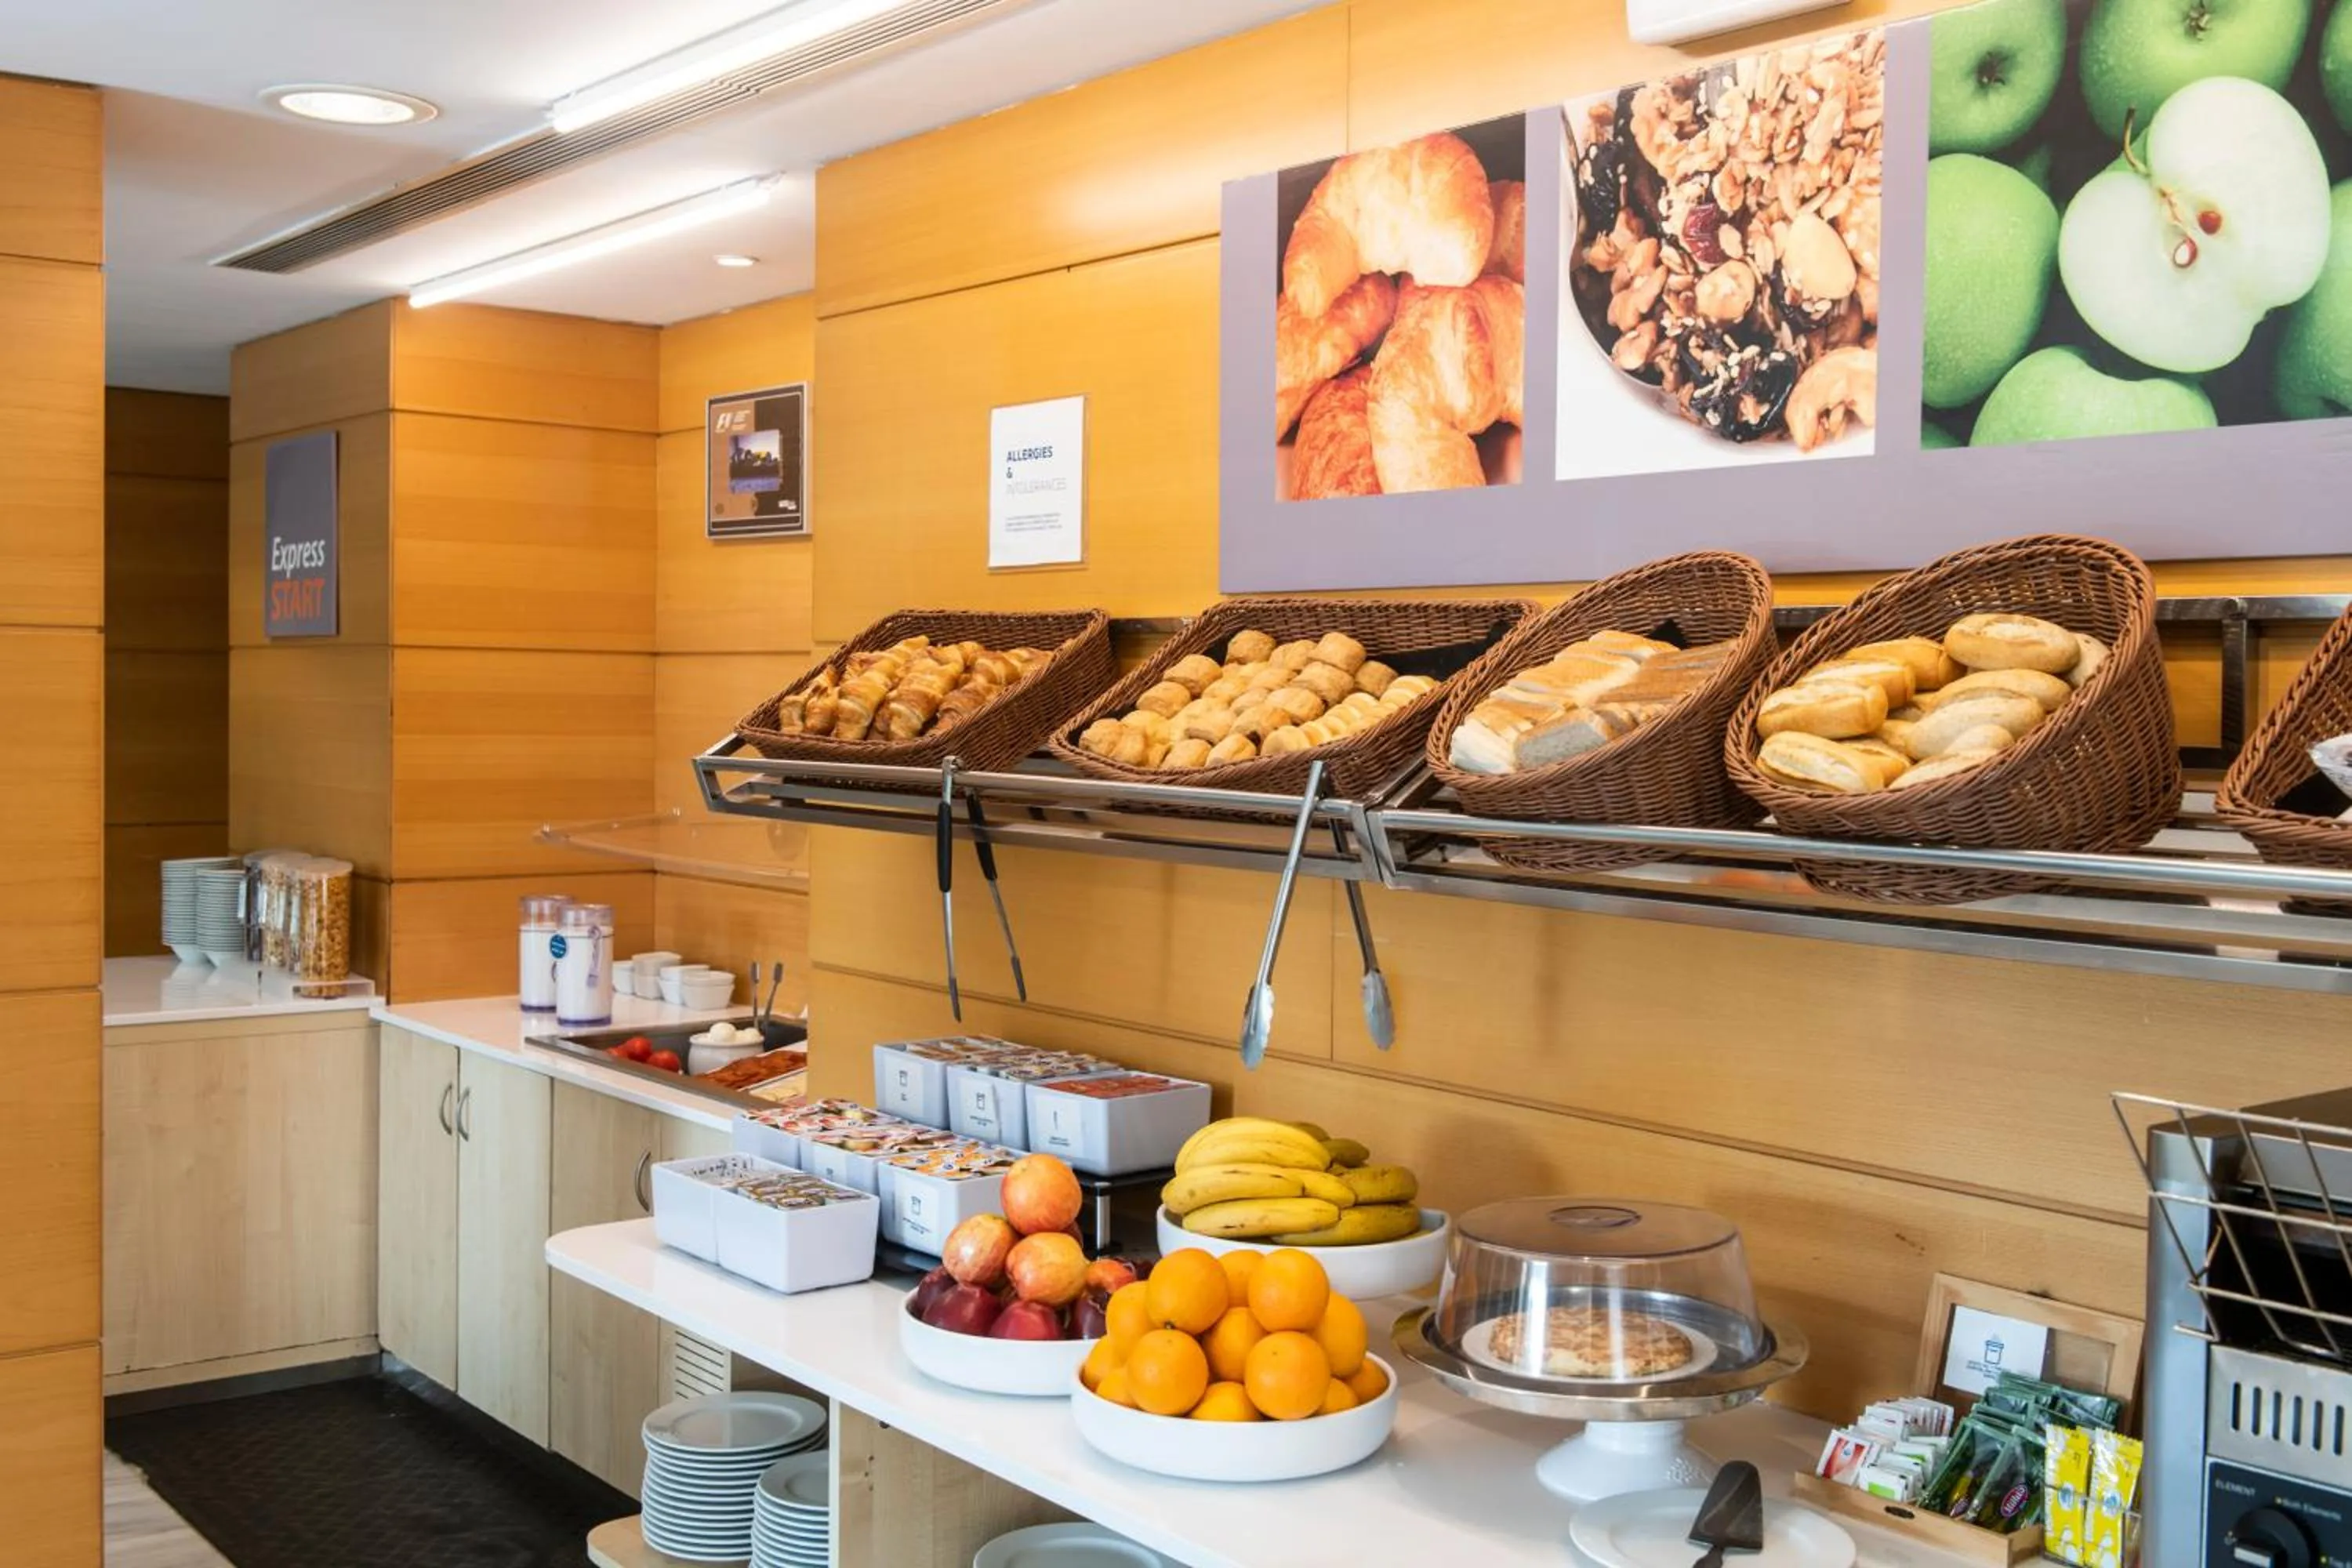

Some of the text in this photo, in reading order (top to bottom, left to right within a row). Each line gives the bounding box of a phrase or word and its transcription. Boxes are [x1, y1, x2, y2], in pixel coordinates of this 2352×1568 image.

[1006, 445, 1053, 462] ALLERGIES
[271, 536, 325, 579] Express
[270, 578, 325, 620] START
